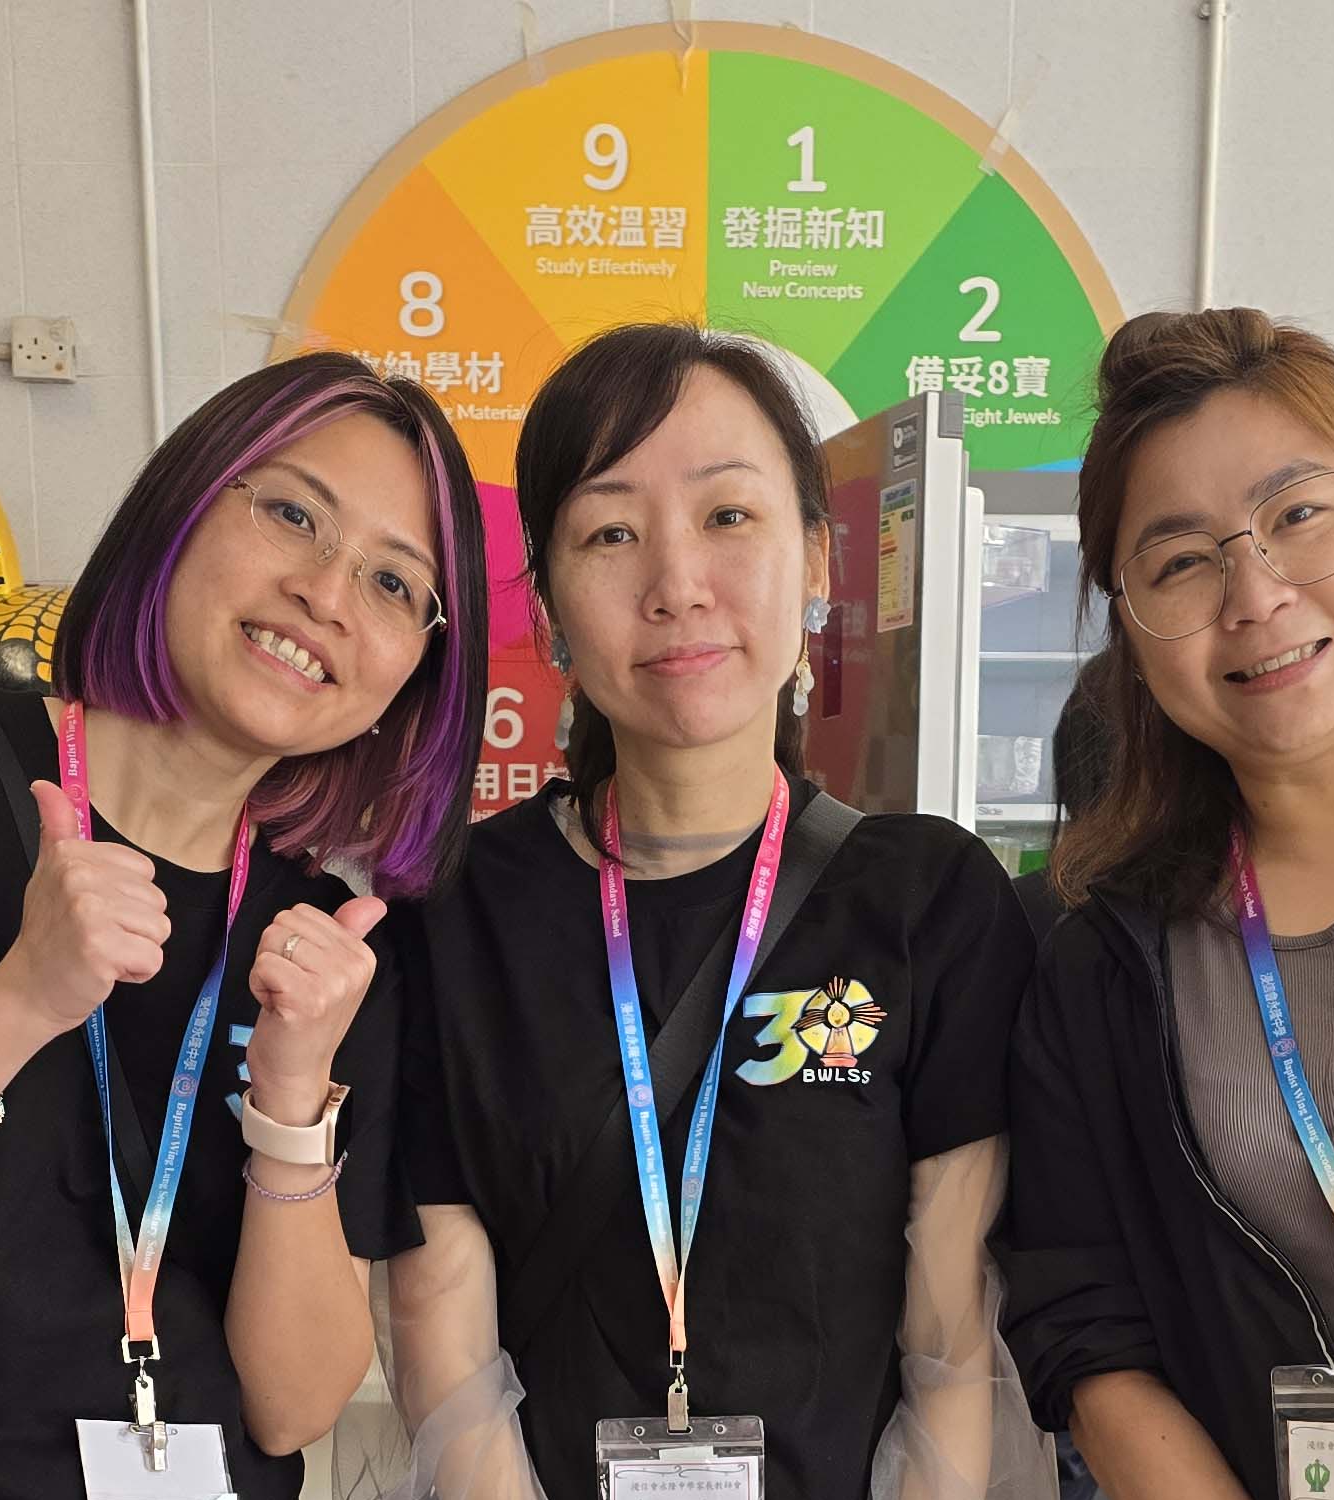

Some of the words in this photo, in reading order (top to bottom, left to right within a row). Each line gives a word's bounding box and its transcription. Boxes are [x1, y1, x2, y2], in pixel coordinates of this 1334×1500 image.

[582, 123, 629, 191] 9
[787, 126, 827, 192] 1
[525, 205, 687, 249] 高效溫習
[723, 206, 884, 249] 發掘新知
[536, 257, 584, 277] Study
[588, 257, 677, 277] Effectively
[769, 259, 838, 278] Preview
[399, 271, 445, 337] 8
[743, 282, 781, 298] New
[784, 281, 863, 301] Concepts
[958, 276, 1002, 342] 2
[905, 355, 1051, 398] 備妥8寶
[962, 407, 1004, 426] Eight
[1007, 408, 1061, 425] Jewels
[484, 687, 524, 749] 6
[66, 743, 79, 776] Baptist
[1243, 891, 1257, 918] School
[610, 908, 622, 937] School
[88, 1007, 102, 1059] Secondar
[802, 1067, 873, 1085] BWLSS
[1282, 1057, 1298, 1088] Baptist
[1293, 1087, 1309, 1116] Wing
[1303, 1115, 1320, 1143] Lung
[170, 1101, 187, 1138] Baptist
[164, 1139, 180, 1166] Wing
[159, 1166, 173, 1190] Lung
[141, 1239, 157, 1271] School
